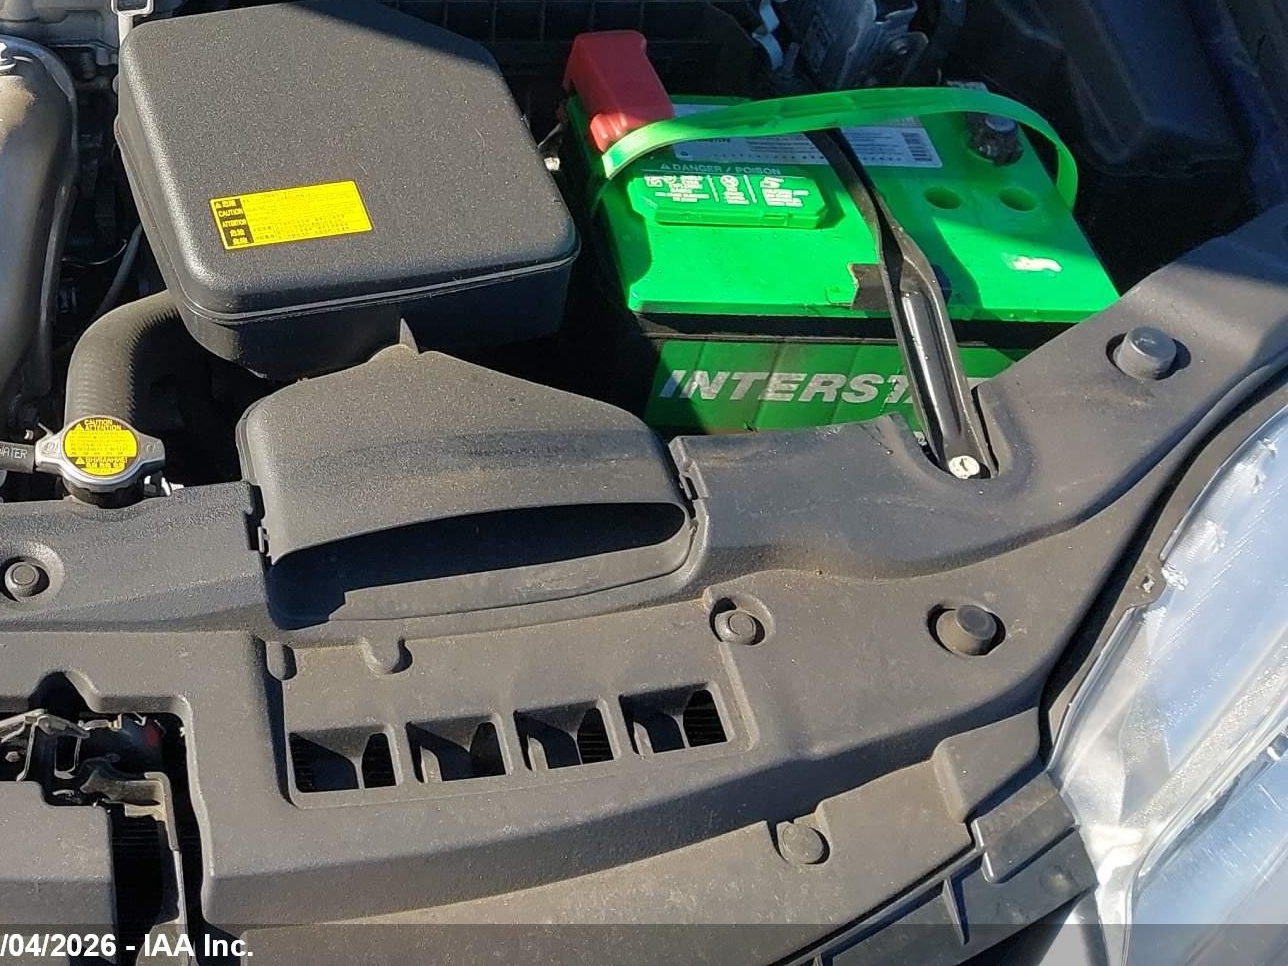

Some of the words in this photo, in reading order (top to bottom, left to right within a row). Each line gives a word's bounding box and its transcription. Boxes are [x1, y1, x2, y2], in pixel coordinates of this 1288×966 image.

[672, 163, 723, 172] DANGER
[735, 166, 782, 175] POISON
[658, 369, 913, 404] INTERST
